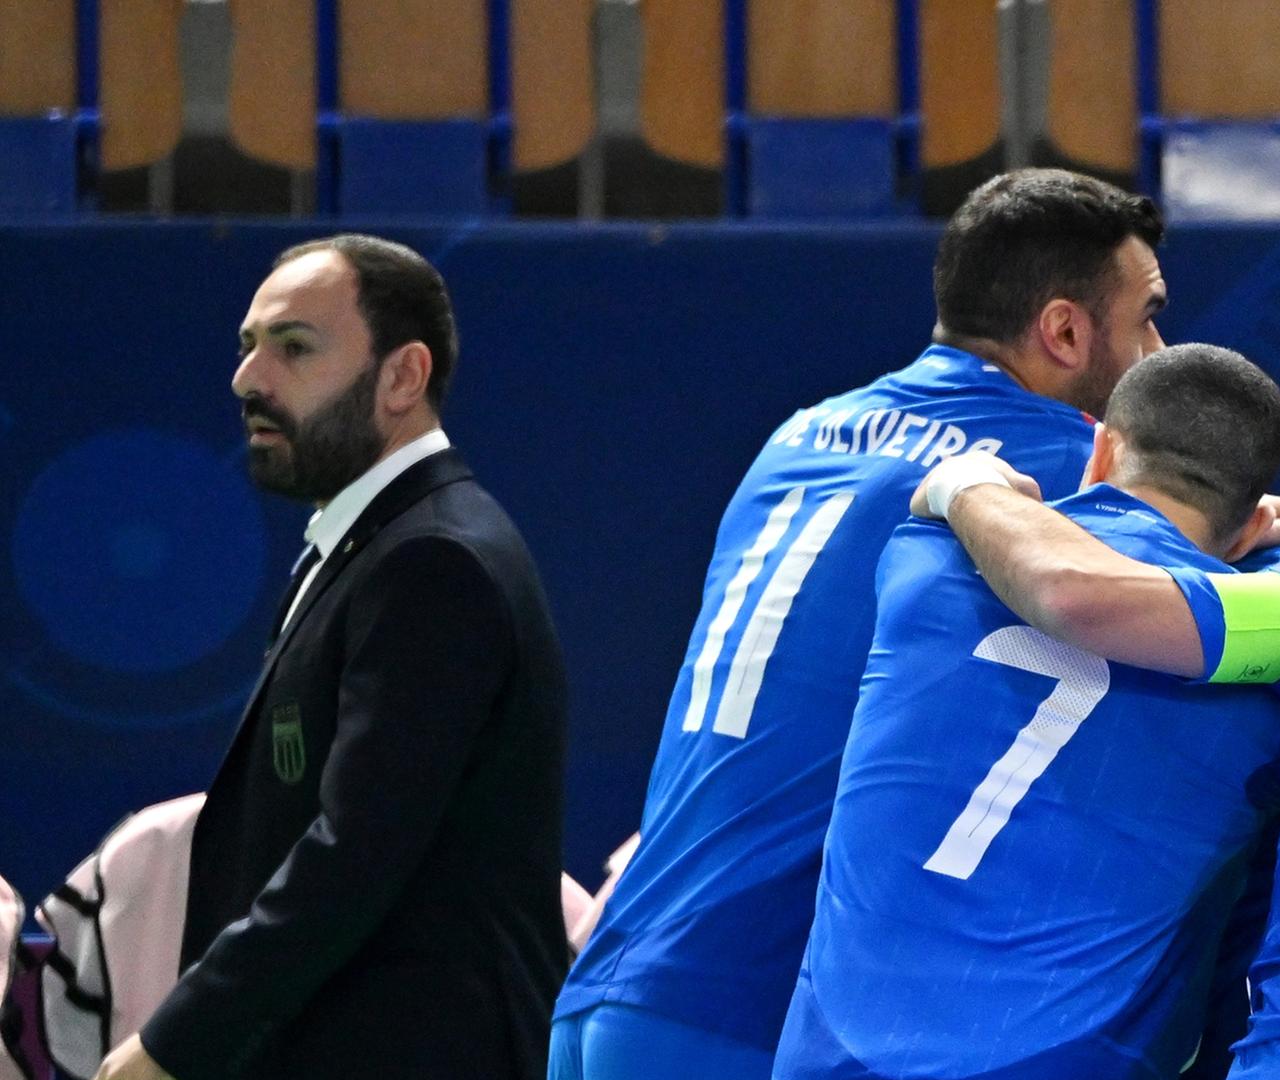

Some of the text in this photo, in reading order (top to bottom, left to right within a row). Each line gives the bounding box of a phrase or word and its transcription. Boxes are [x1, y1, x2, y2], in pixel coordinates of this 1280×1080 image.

[772, 408, 831, 447] DE
[682, 486, 856, 740] 11
[922, 625, 1110, 880] 7
